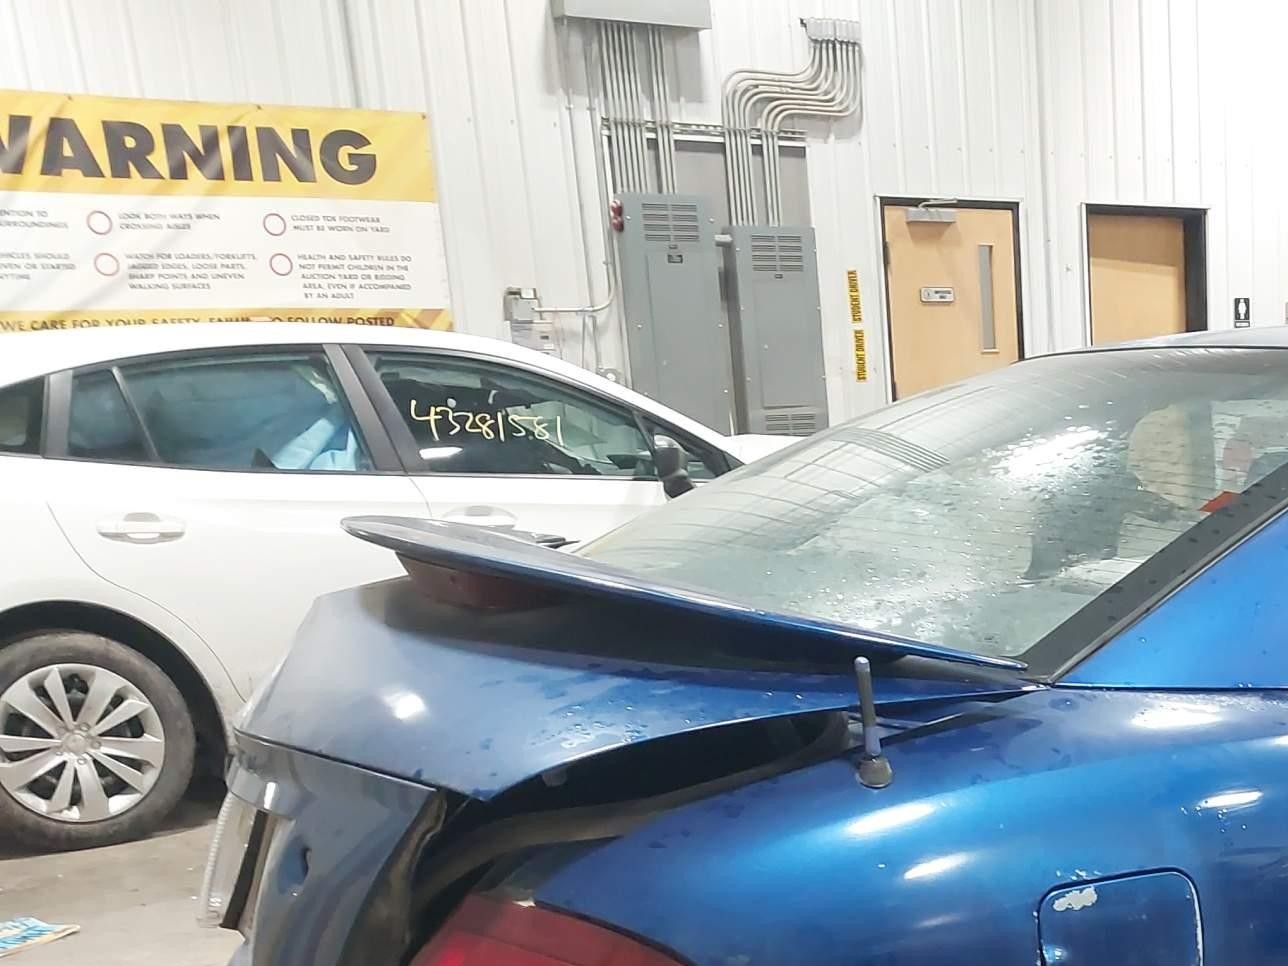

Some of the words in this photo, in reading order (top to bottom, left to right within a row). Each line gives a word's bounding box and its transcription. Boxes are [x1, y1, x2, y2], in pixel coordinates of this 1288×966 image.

[847, 270, 858, 293] DRIVER
[851, 294, 862, 322] STUDENT
[30, 319, 67, 331] CARE
[72, 319, 100, 329] FOR
[105, 318, 146, 327] YOUR
[347, 316, 394, 327] POSTED
[854, 330, 865, 352] DRIVER
[856, 353, 867, 381] STUDENT
[411, 399, 564, 446] 43281581
